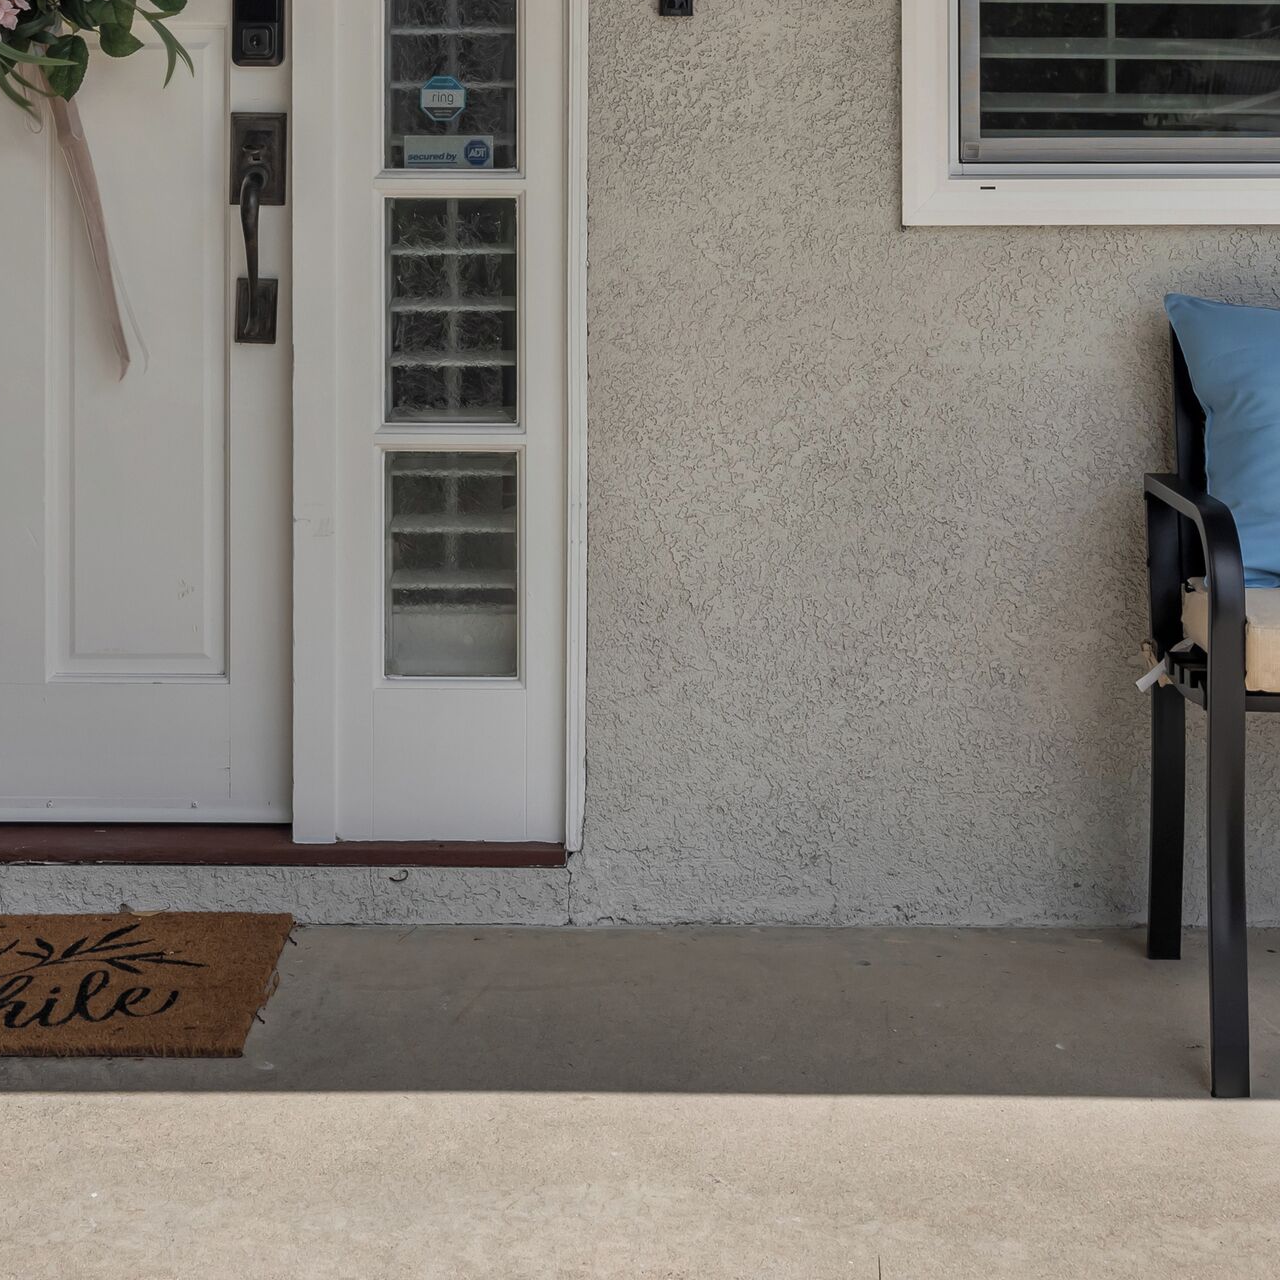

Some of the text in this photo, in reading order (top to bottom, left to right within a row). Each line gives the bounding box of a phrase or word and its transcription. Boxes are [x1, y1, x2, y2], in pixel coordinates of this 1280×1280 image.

[432, 91, 454, 105] ring
[407, 147, 487, 162] secured by ADT
